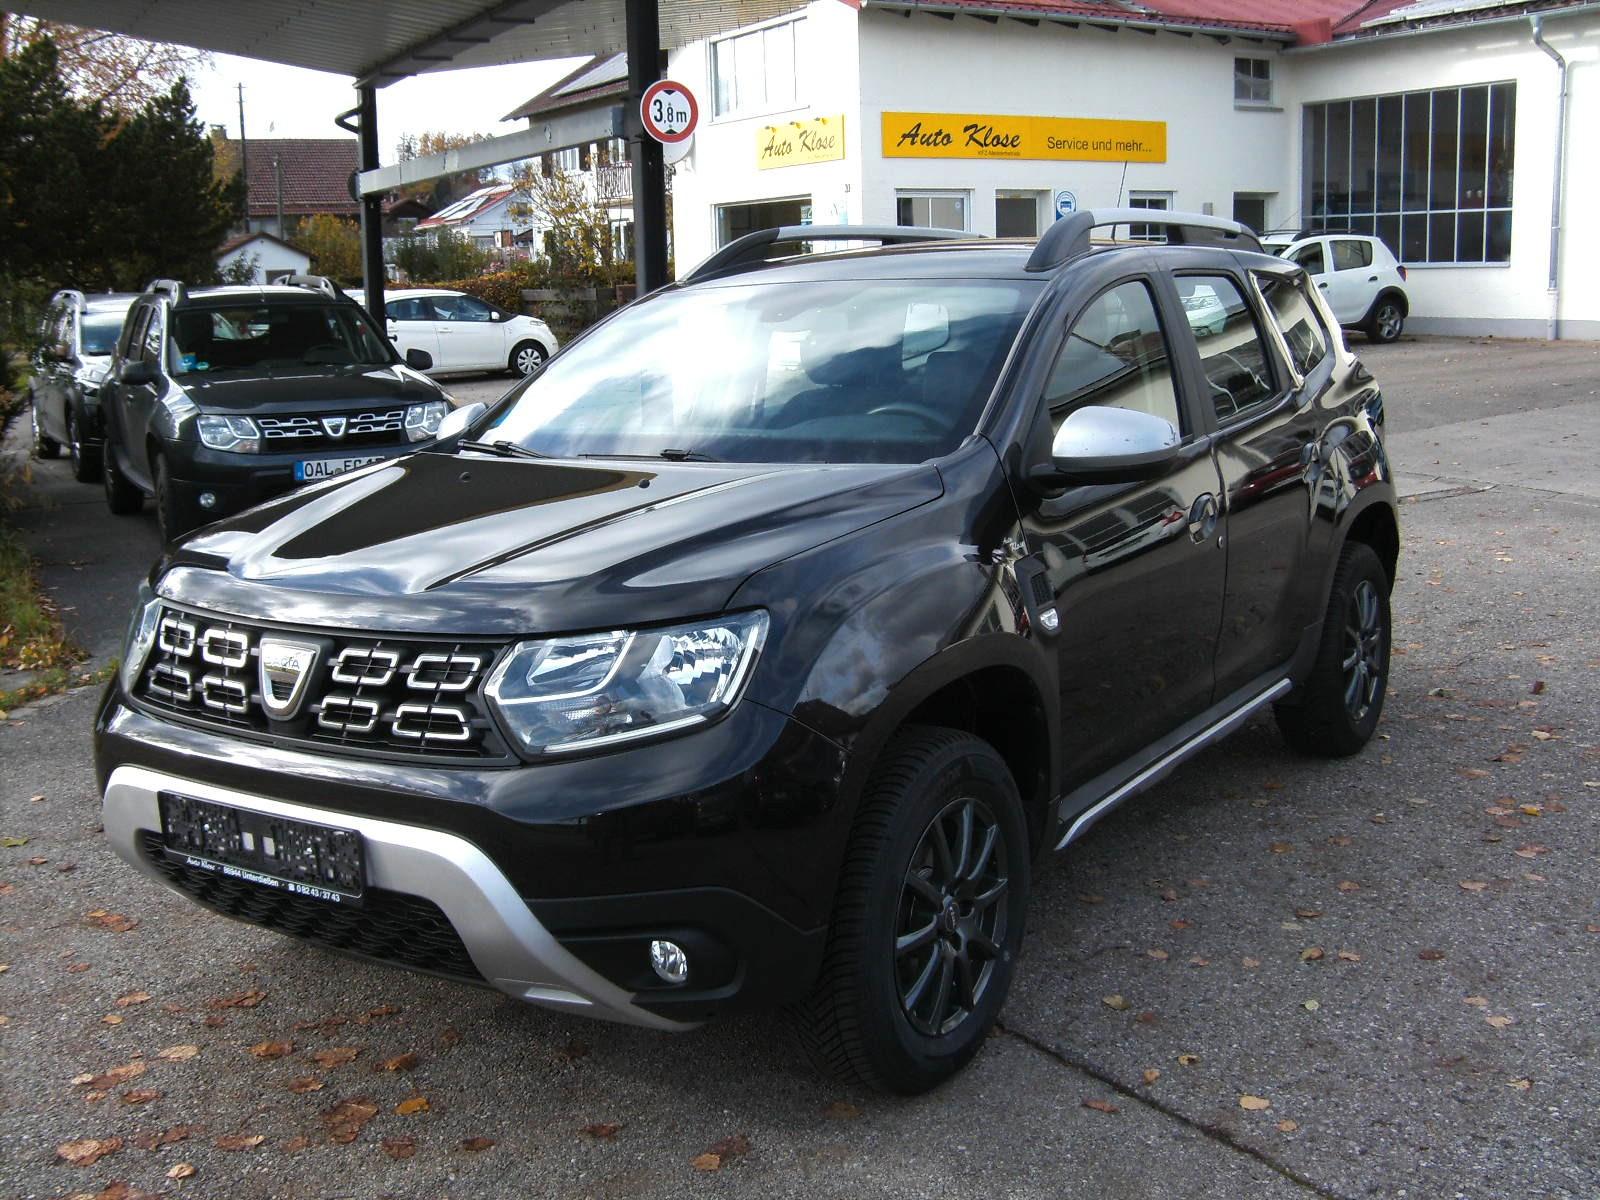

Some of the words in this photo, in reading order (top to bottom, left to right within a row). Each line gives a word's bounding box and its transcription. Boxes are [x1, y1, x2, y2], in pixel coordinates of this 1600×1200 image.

[762, 134, 793, 160] Auto
[799, 129, 836, 153] Klose
[896, 121, 953, 148] Auto
[963, 123, 1021, 148] Klose
[1047, 136, 1089, 150] Service
[1092, 138, 1112, 151] und
[304, 461, 334, 478] OAL
